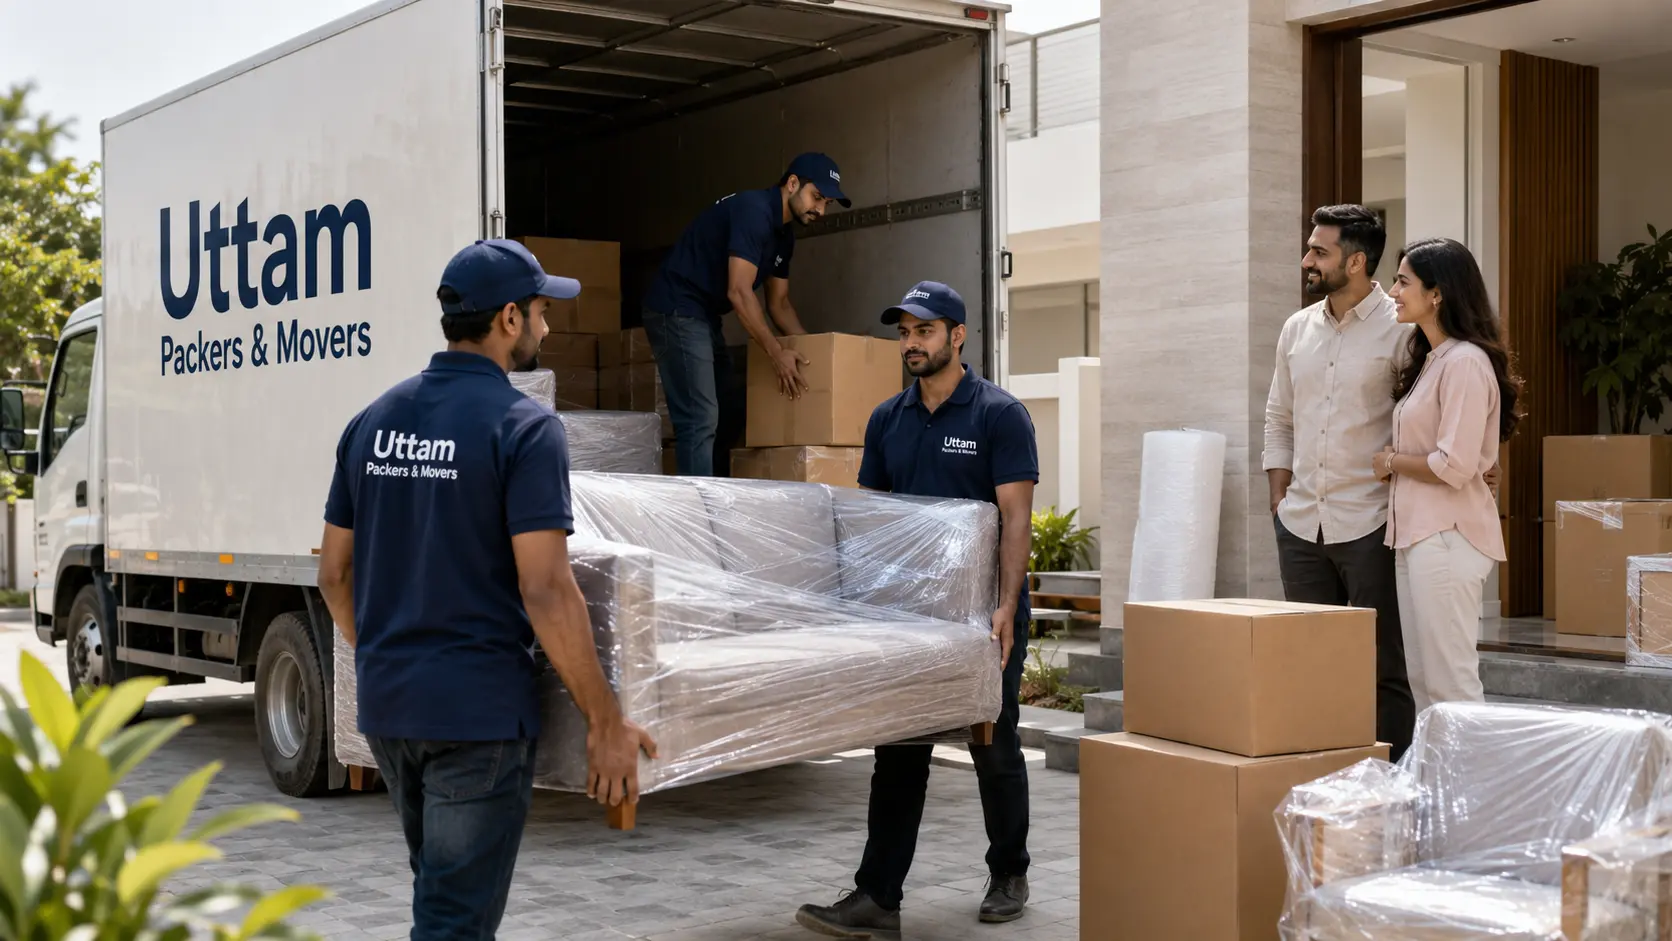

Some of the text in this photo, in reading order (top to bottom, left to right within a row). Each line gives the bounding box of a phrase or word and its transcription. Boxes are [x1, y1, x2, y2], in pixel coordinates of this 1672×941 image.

[160, 196, 371, 320] Uttam
[161, 318, 372, 376] Packers & Movers
[373, 429, 456, 462] Uttam
[944, 436, 976, 449] Uttam
[366, 461, 458, 480] Packers & Movers
